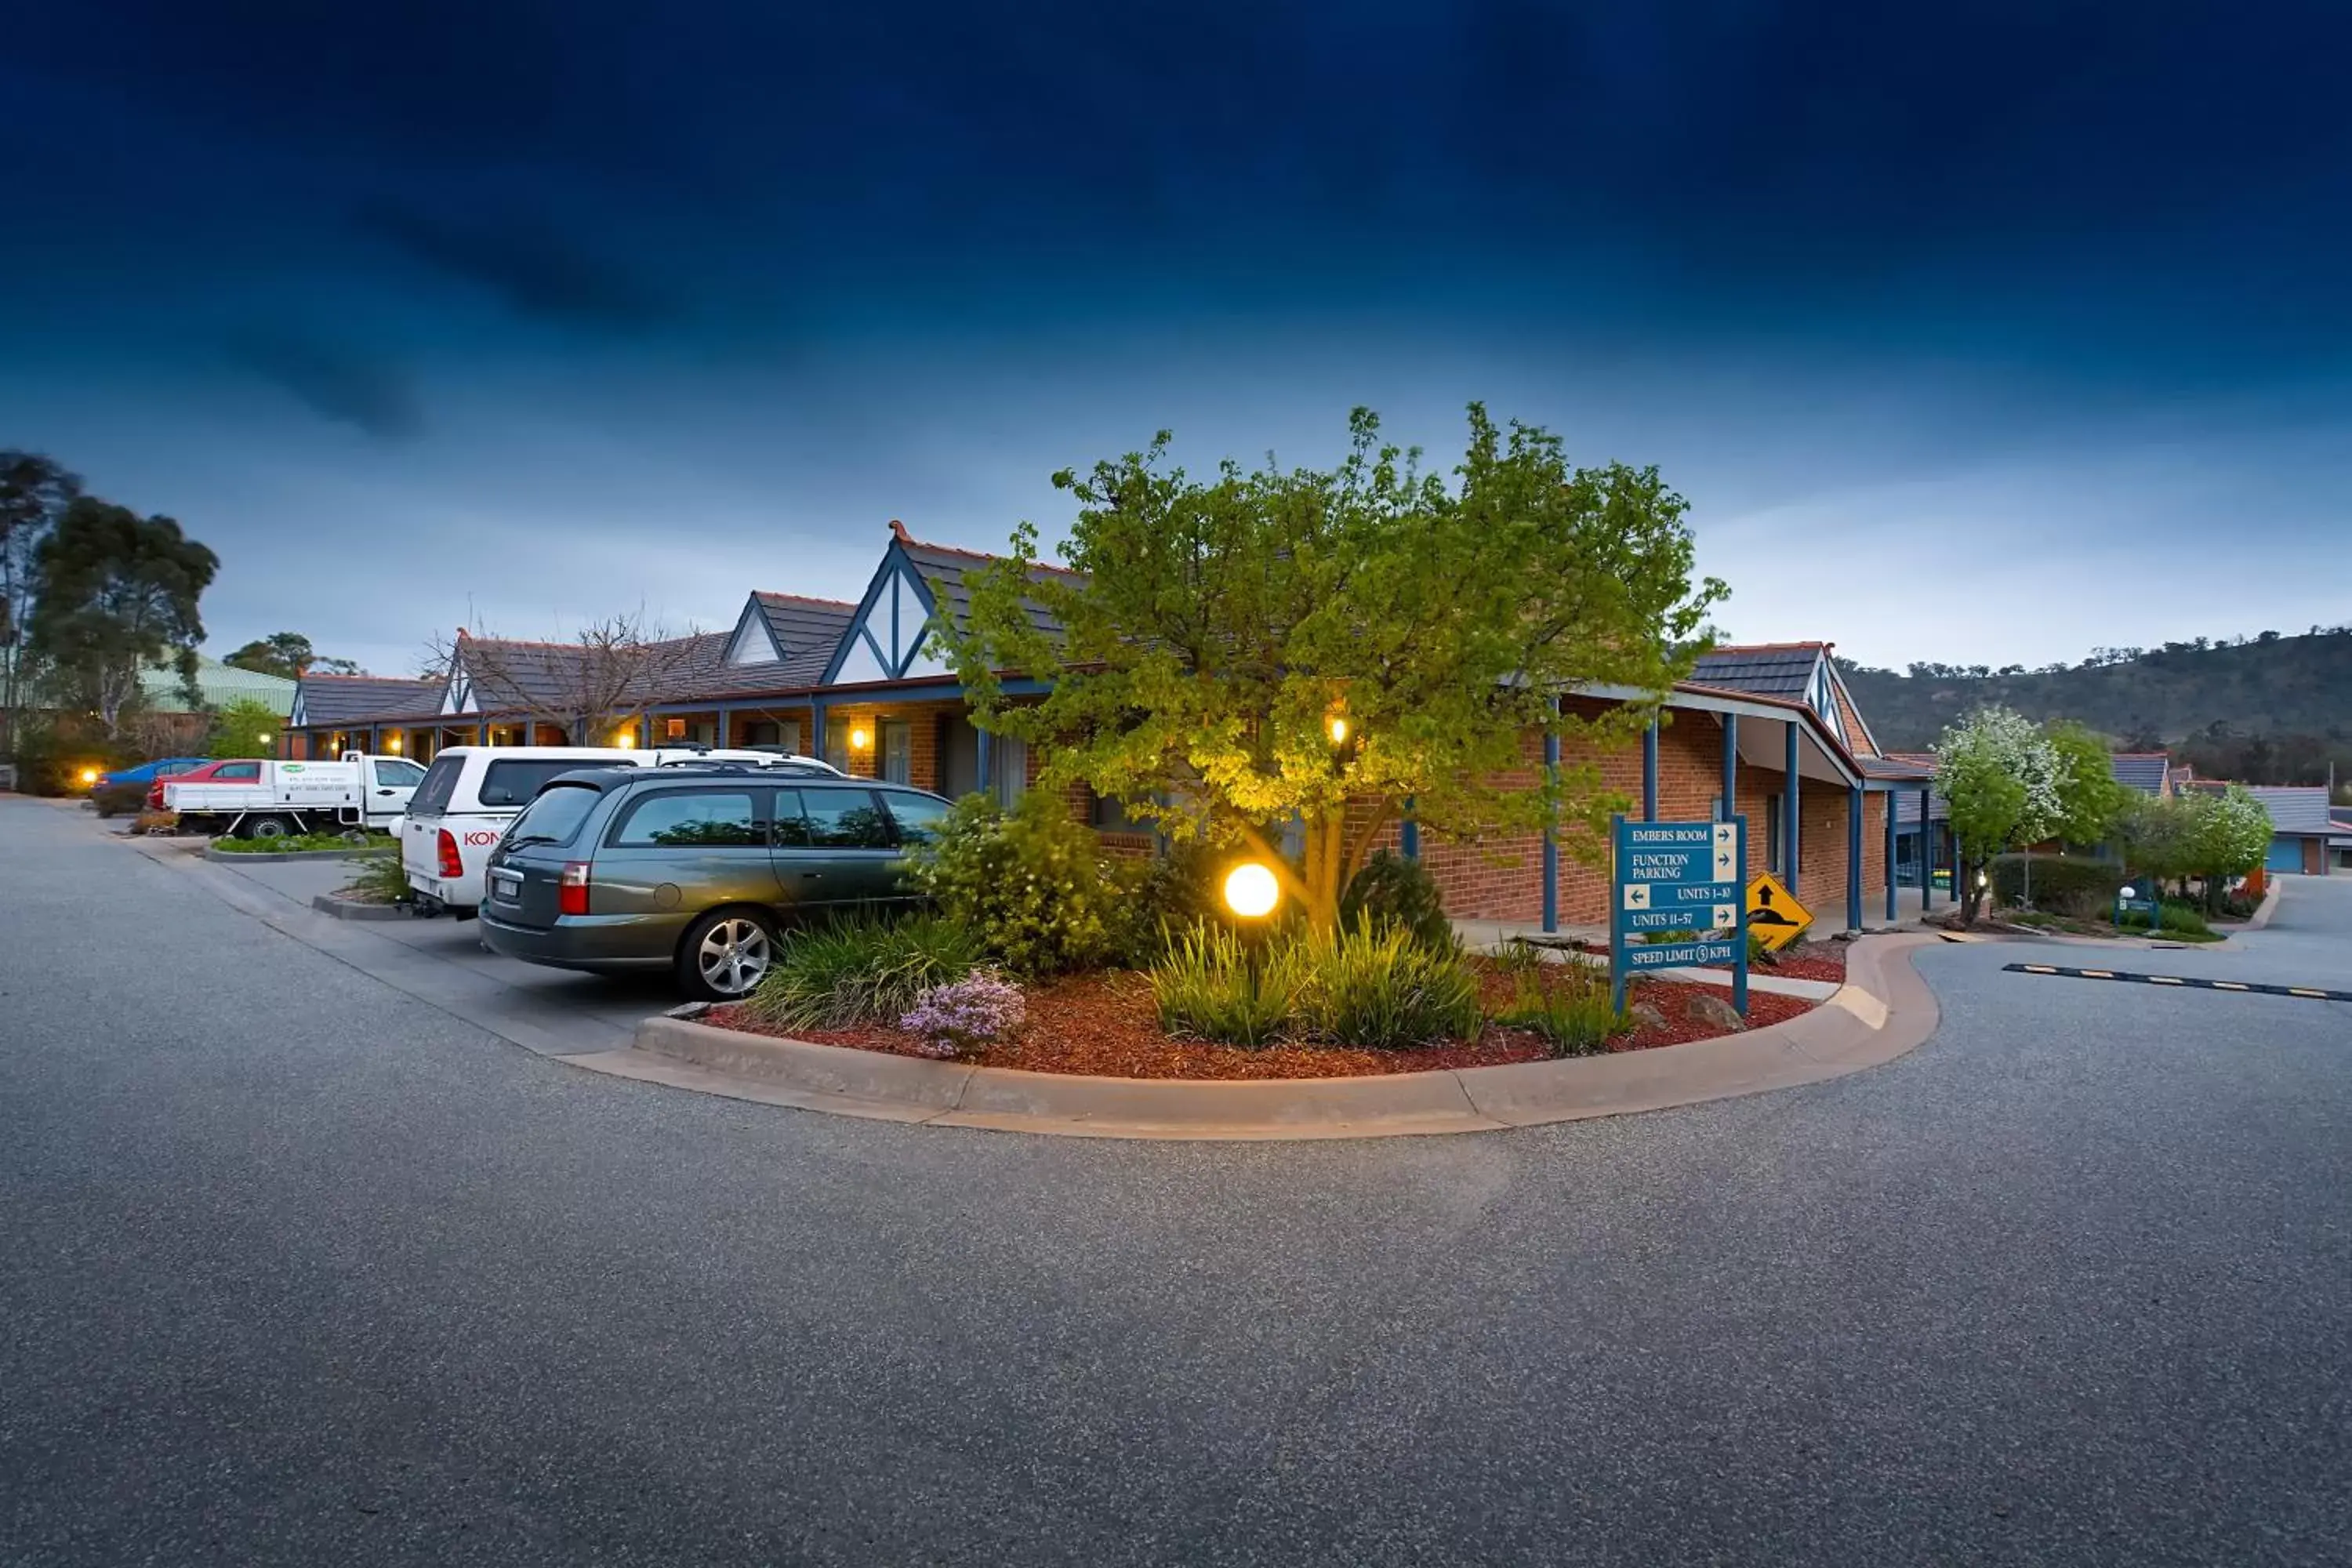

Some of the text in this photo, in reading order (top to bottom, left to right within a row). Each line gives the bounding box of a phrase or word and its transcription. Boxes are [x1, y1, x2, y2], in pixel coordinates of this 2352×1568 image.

[1632, 830, 1708, 841] EMBERS ROOM
[1632, 854, 1689, 866] FUNCTION
[1632, 867, 1681, 879] PARKING
[1677, 887, 1710, 900] UNITS
[1632, 913, 1693, 927] UNITS 11-57
[1632, 951, 1663, 965] SPEED
[1666, 949, 1695, 962] LIMIT
[1710, 946, 1731, 958] KPH
